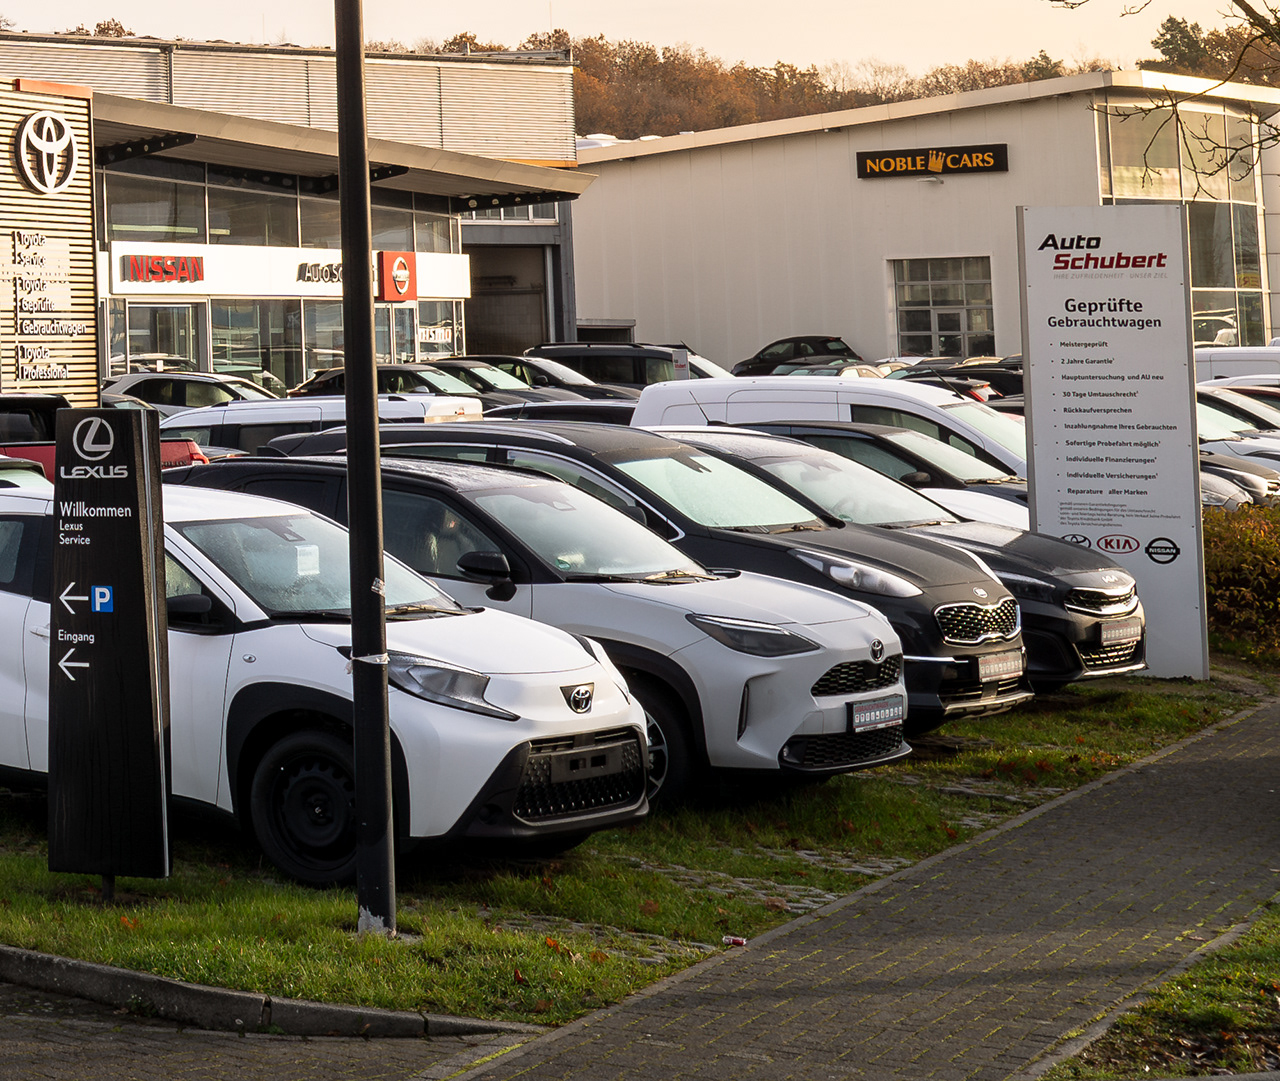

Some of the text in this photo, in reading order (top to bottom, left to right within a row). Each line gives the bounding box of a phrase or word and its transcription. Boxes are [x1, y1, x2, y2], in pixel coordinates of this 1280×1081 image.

[865, 151, 995, 173] NOBLE CARS
[19, 231, 47, 249] Toyota
[1037, 233, 1102, 251] Auto
[18, 251, 46, 268] Service
[1053, 252, 1168, 270] Schubert
[129, 255, 204, 282] NISSAN
[20, 278, 48, 295] Toyota
[22, 297, 55, 315] Geprüfte
[1064, 298, 1143, 316] Geprüfte
[22, 319, 87, 336] Gebrauchtwagen
[1047, 316, 1162, 331] Gebrauchtwagen
[1059, 341, 1109, 349] Meistergeprüft
[22, 345, 50, 362] Toyota
[23, 364, 69, 380] Professional
[1061, 374, 1125, 382] Hauptuntersuchung
[1072, 391, 1087, 399] Tage
[1063, 407, 1133, 415] Rückkaufversprechen
[1064, 423, 1118, 431] Inzahlungnahme
[1136, 423, 1178, 431] Gebrauchten
[1065, 440, 1096, 448] Sofortige
[1097, 440, 1133, 448] Probefahrt
[59, 465, 129, 479] LEXUS
[1066, 471, 1105, 479] Individuelle
[1108, 488, 1123, 496] aller
[59, 501, 132, 518] Willkommen
[58, 519, 84, 531] Lexus
[58, 533, 91, 545] Service
[1103, 538, 1133, 550] KIA
[57, 629, 95, 644] Eingang
